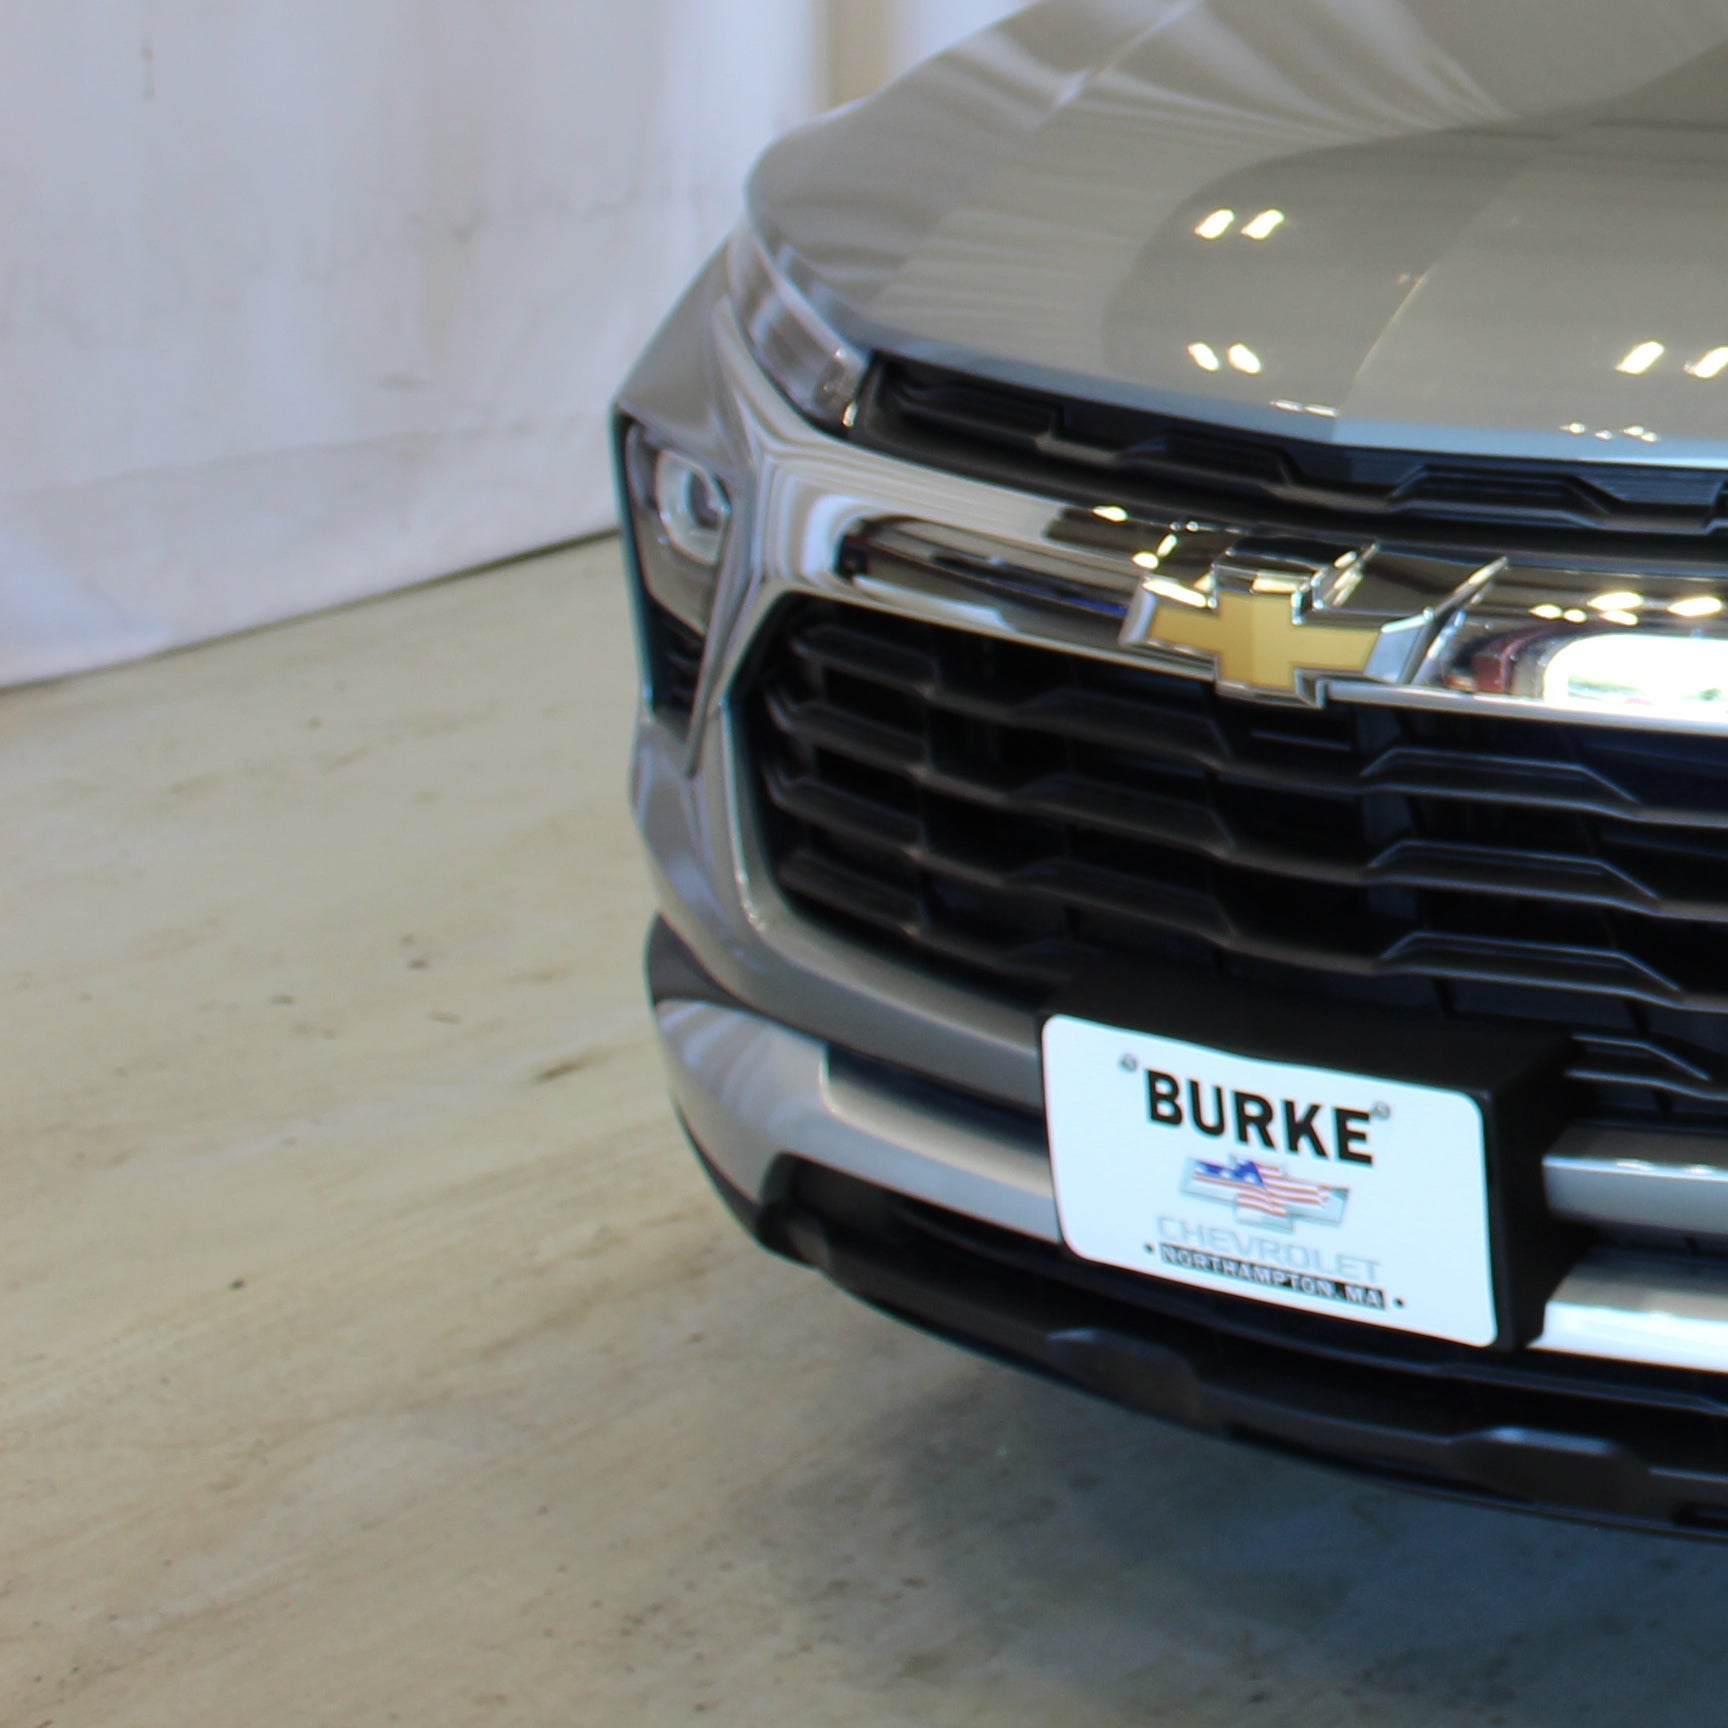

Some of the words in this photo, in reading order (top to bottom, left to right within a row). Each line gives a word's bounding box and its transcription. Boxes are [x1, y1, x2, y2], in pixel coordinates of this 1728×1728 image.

[1144, 1069, 1373, 1165] BURKE
[1157, 1215, 1380, 1283] CHEVROLET
[1345, 1286, 1381, 1309] MA
